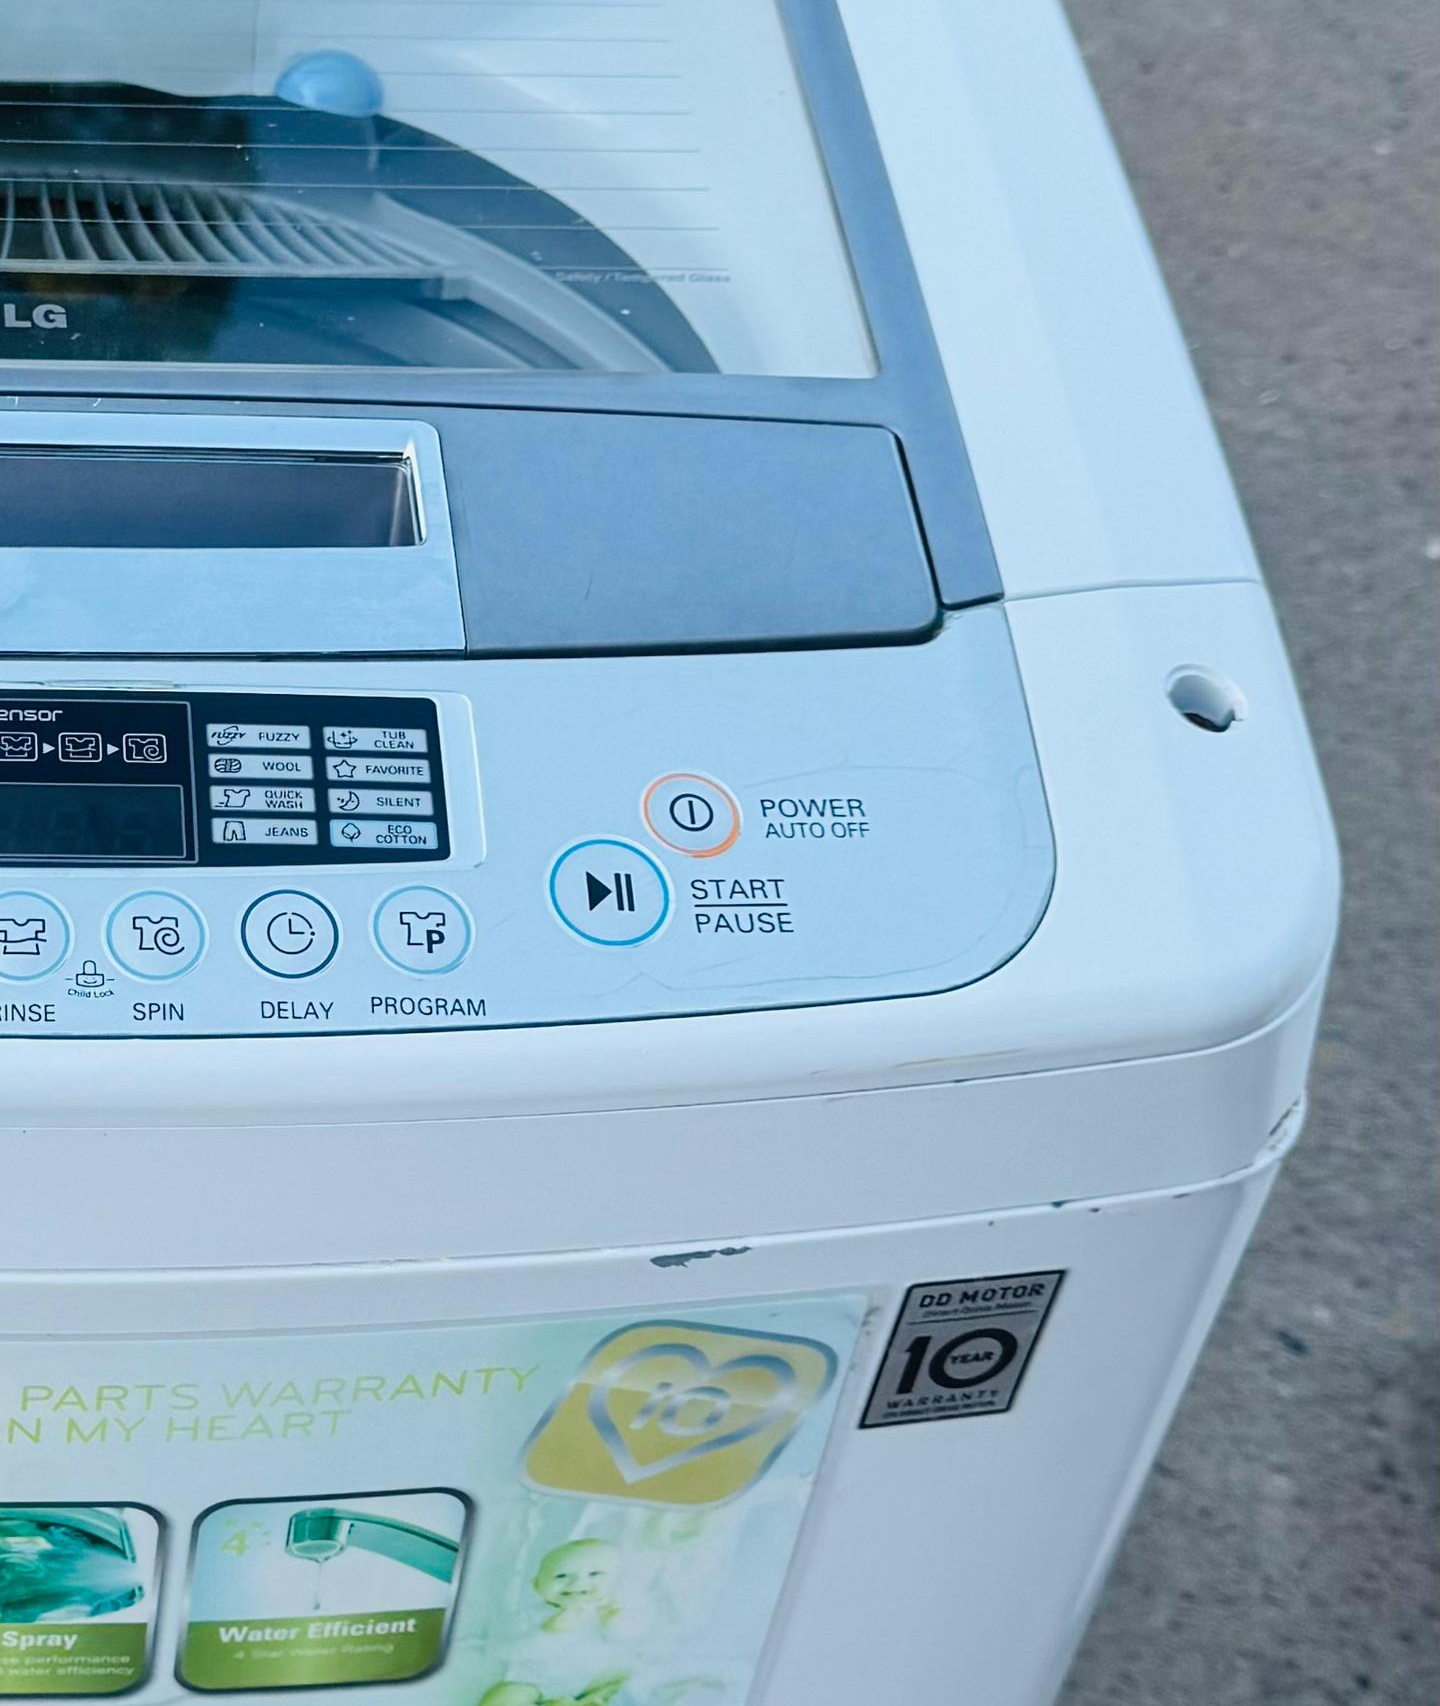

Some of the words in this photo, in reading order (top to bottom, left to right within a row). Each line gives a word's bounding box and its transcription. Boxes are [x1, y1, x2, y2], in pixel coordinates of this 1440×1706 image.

[3, 303, 67, 328] LG
[258, 731, 300, 742] FUZZY
[382, 730, 406, 740] TUB
[374, 740, 414, 749] CLEAN
[262, 761, 302, 772] WOOL
[365, 764, 424, 776] FAVORITE
[264, 790, 303, 799] QUICK
[376, 796, 422, 807] SILENT
[266, 799, 303, 809] WASH
[760, 798, 866, 818] POWER
[265, 826, 309, 837] JEANS
[387, 824, 412, 834] ECO
[765, 822, 825, 839] AUTO
[832, 822, 870, 838] OFF
[375, 834, 427, 845] COTTON
[690, 879, 785, 900] START
[695, 912, 795, 933] PAUSE
[67, 988, 91, 998] Child
[94, 988, 115, 998] Lock
[132, 1002, 185, 1021] SPIN
[260, 1000, 334, 1020] DELAY
[370, 996, 488, 1017] PROGRAM
[919, 1293, 952, 1308] DD
[959, 1283, 1045, 1304] MOTOR
[895, 1327, 1018, 1395] 10
[950, 1351, 994, 1364] YEAR
[21, 1384, 200, 1412] PARTS
[220, 1365, 541, 1408] WARRANTY
[887, 1390, 999, 1409] WARRANTY
[66, 1417, 145, 1444] MY
[165, 1410, 351, 1443] HEART
[219, 1626, 301, 1643] Water
[307, 1618, 417, 1639] Efficient
[1, 1630, 78, 1650] Spray
